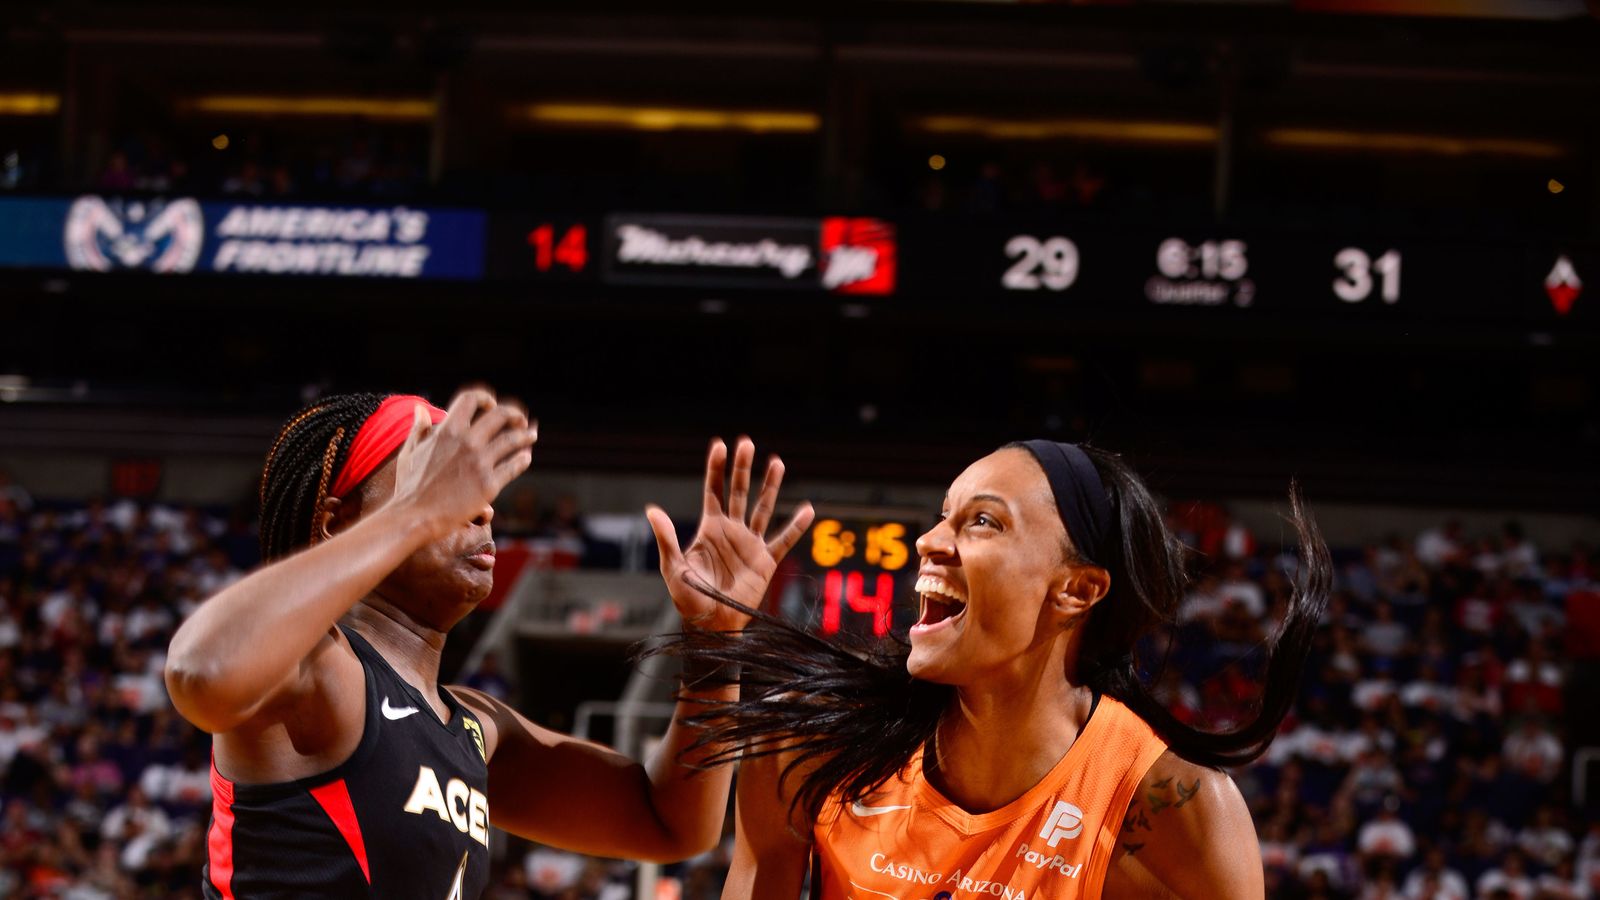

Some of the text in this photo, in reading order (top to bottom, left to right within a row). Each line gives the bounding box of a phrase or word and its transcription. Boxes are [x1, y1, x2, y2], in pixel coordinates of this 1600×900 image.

[217, 206, 429, 243] AMERICA'S
[527, 224, 589, 271] 14
[213, 239, 430, 277] FRONTLINE
[1002, 235, 1080, 291] 29
[1156, 237, 1249, 280] 6:15
[1333, 247, 1401, 304] 31
[811, 519, 909, 570] 6:15
[822, 569, 895, 638] 14
[403, 765, 489, 851] ACE
[1015, 843, 1082, 879] PayPal
